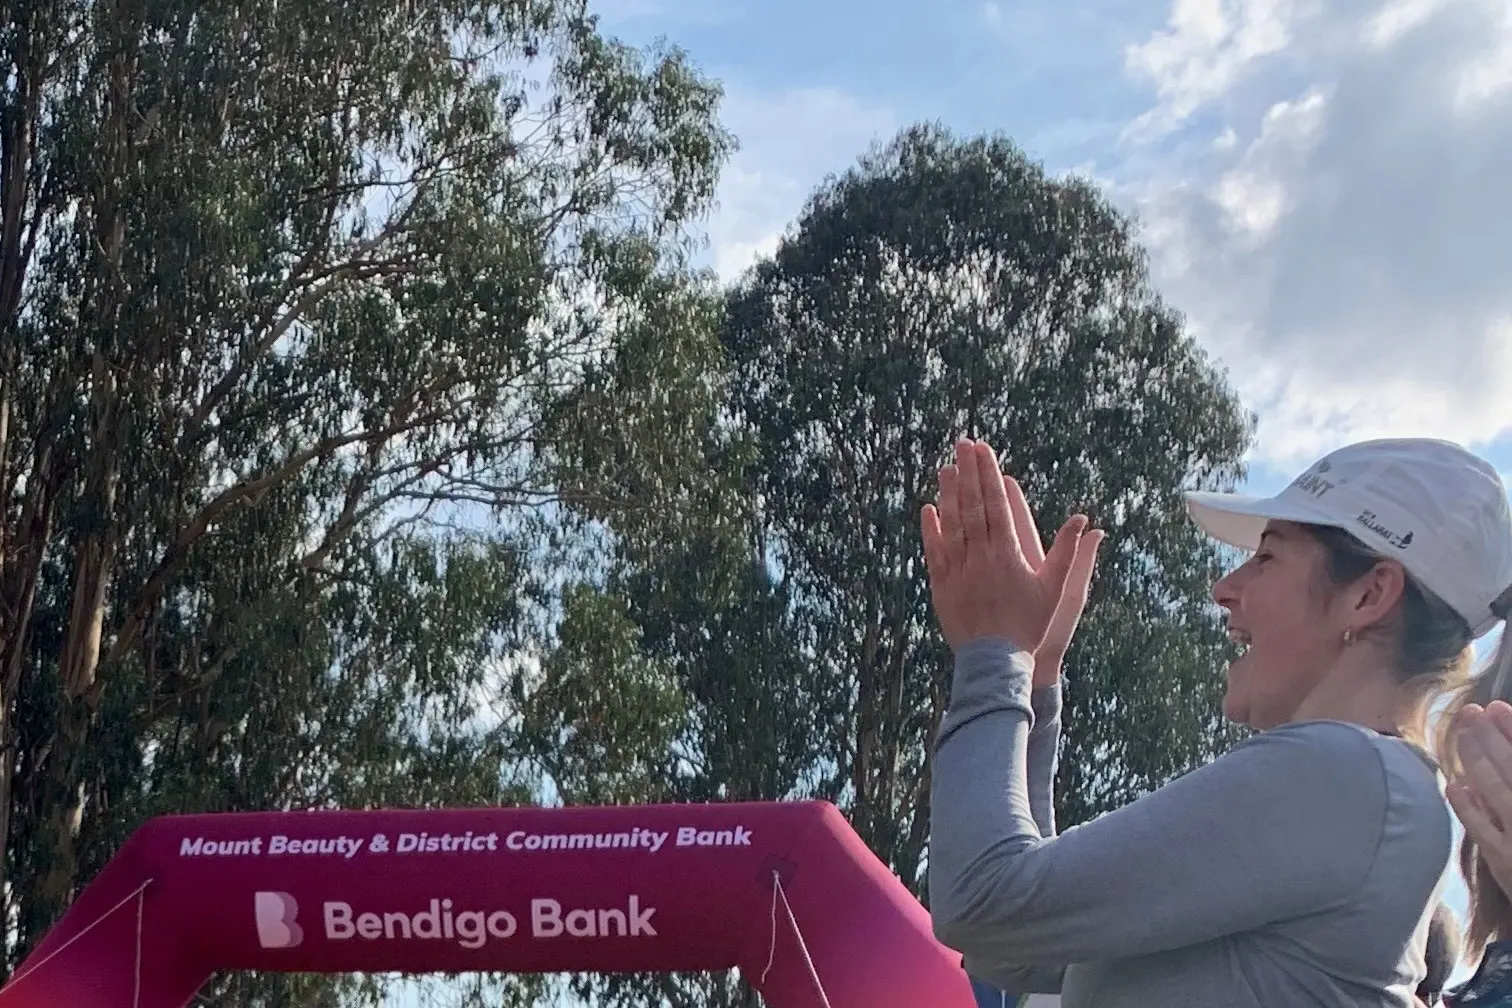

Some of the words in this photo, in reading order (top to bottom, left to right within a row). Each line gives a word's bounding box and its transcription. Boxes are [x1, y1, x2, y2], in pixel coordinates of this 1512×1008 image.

[179, 836, 262, 856] Mount
[268, 835, 364, 859] Beauty
[368, 833, 390, 853] &
[396, 831, 499, 853] District
[506, 827, 669, 853] Community
[676, 825, 753, 847] Bank
[323, 898, 518, 949] Bendigo
[530, 895, 658, 938] Bank
